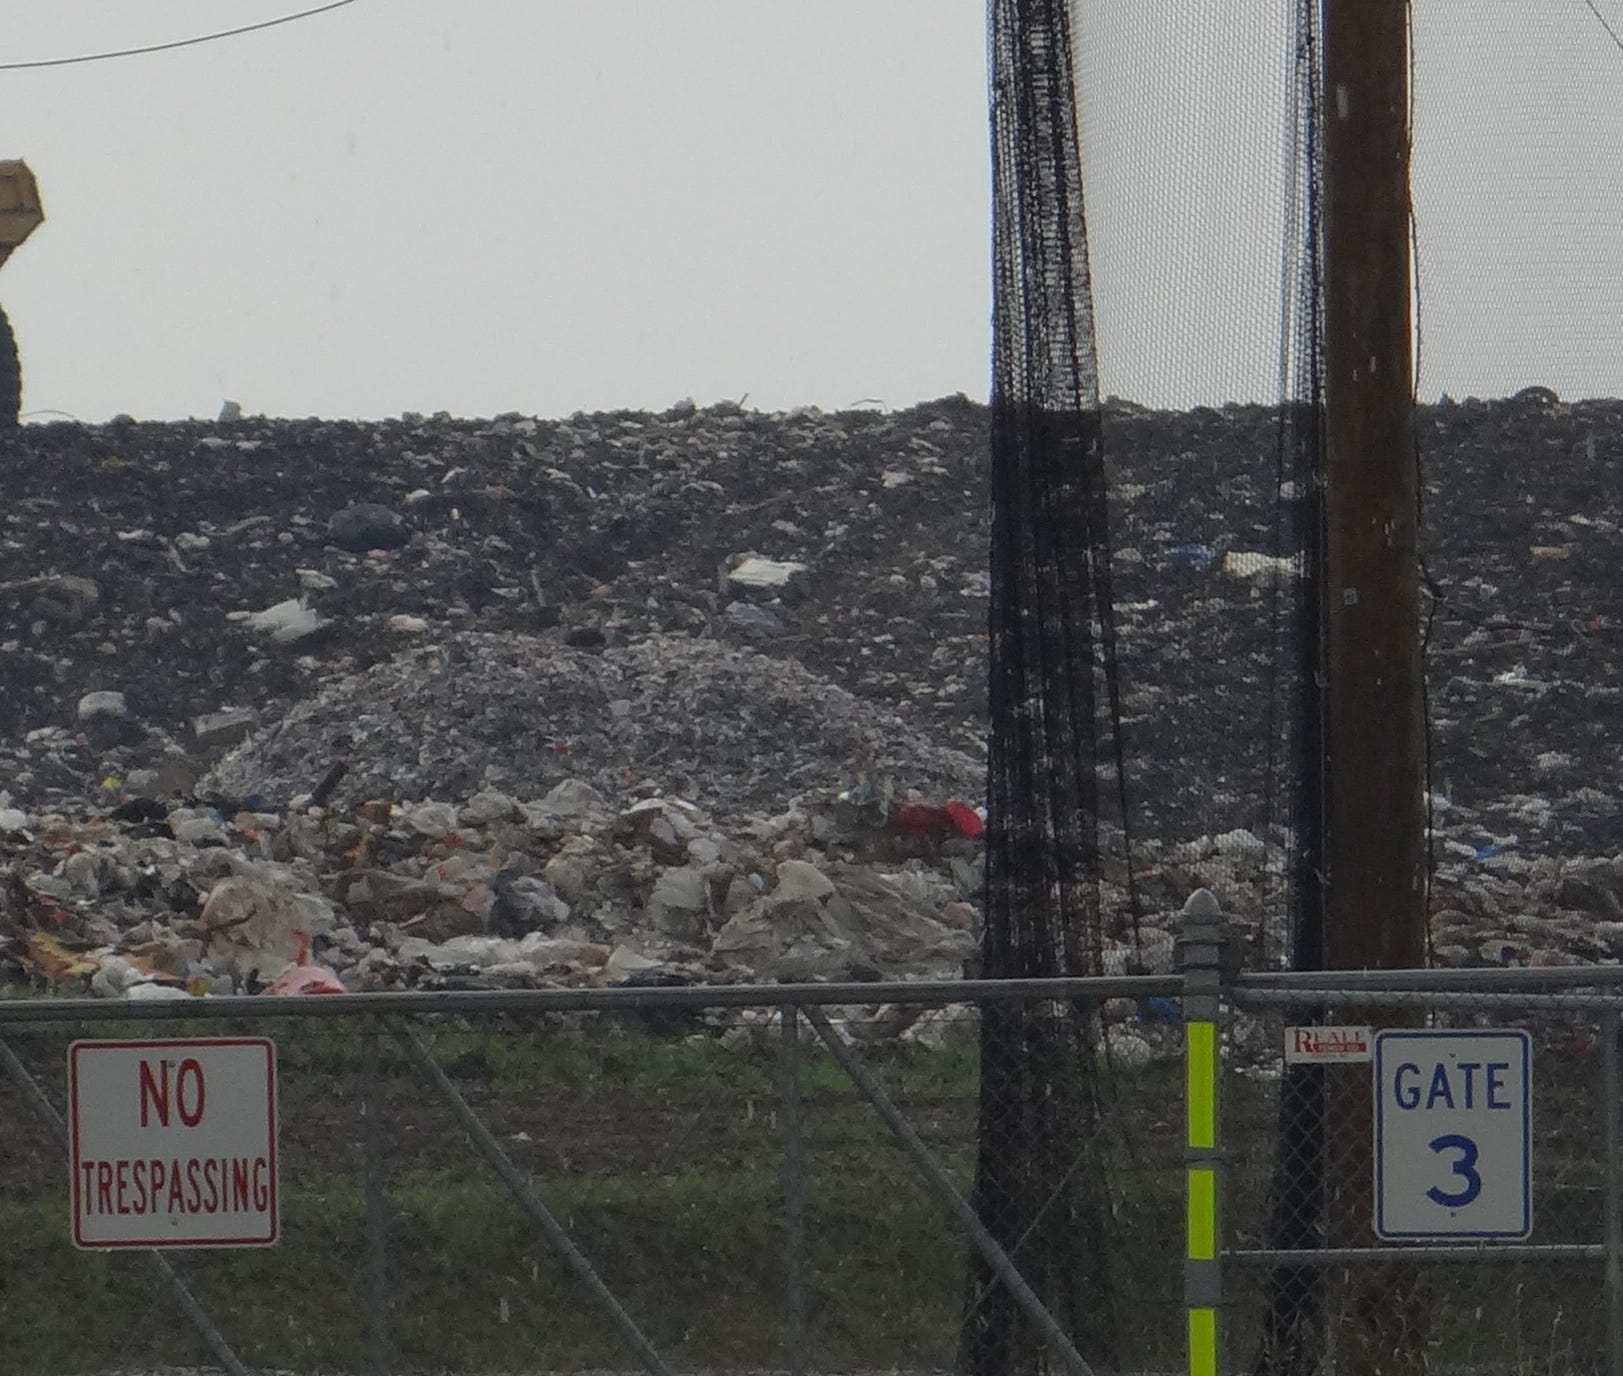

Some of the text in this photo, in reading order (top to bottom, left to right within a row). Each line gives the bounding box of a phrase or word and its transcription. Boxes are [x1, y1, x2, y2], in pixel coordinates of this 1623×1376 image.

[139, 1058, 205, 1127] NO
[1394, 1062, 1511, 1111] GATE
[81, 1158, 268, 1215] TRESPASSING
[1425, 1134, 1482, 1208] 3
